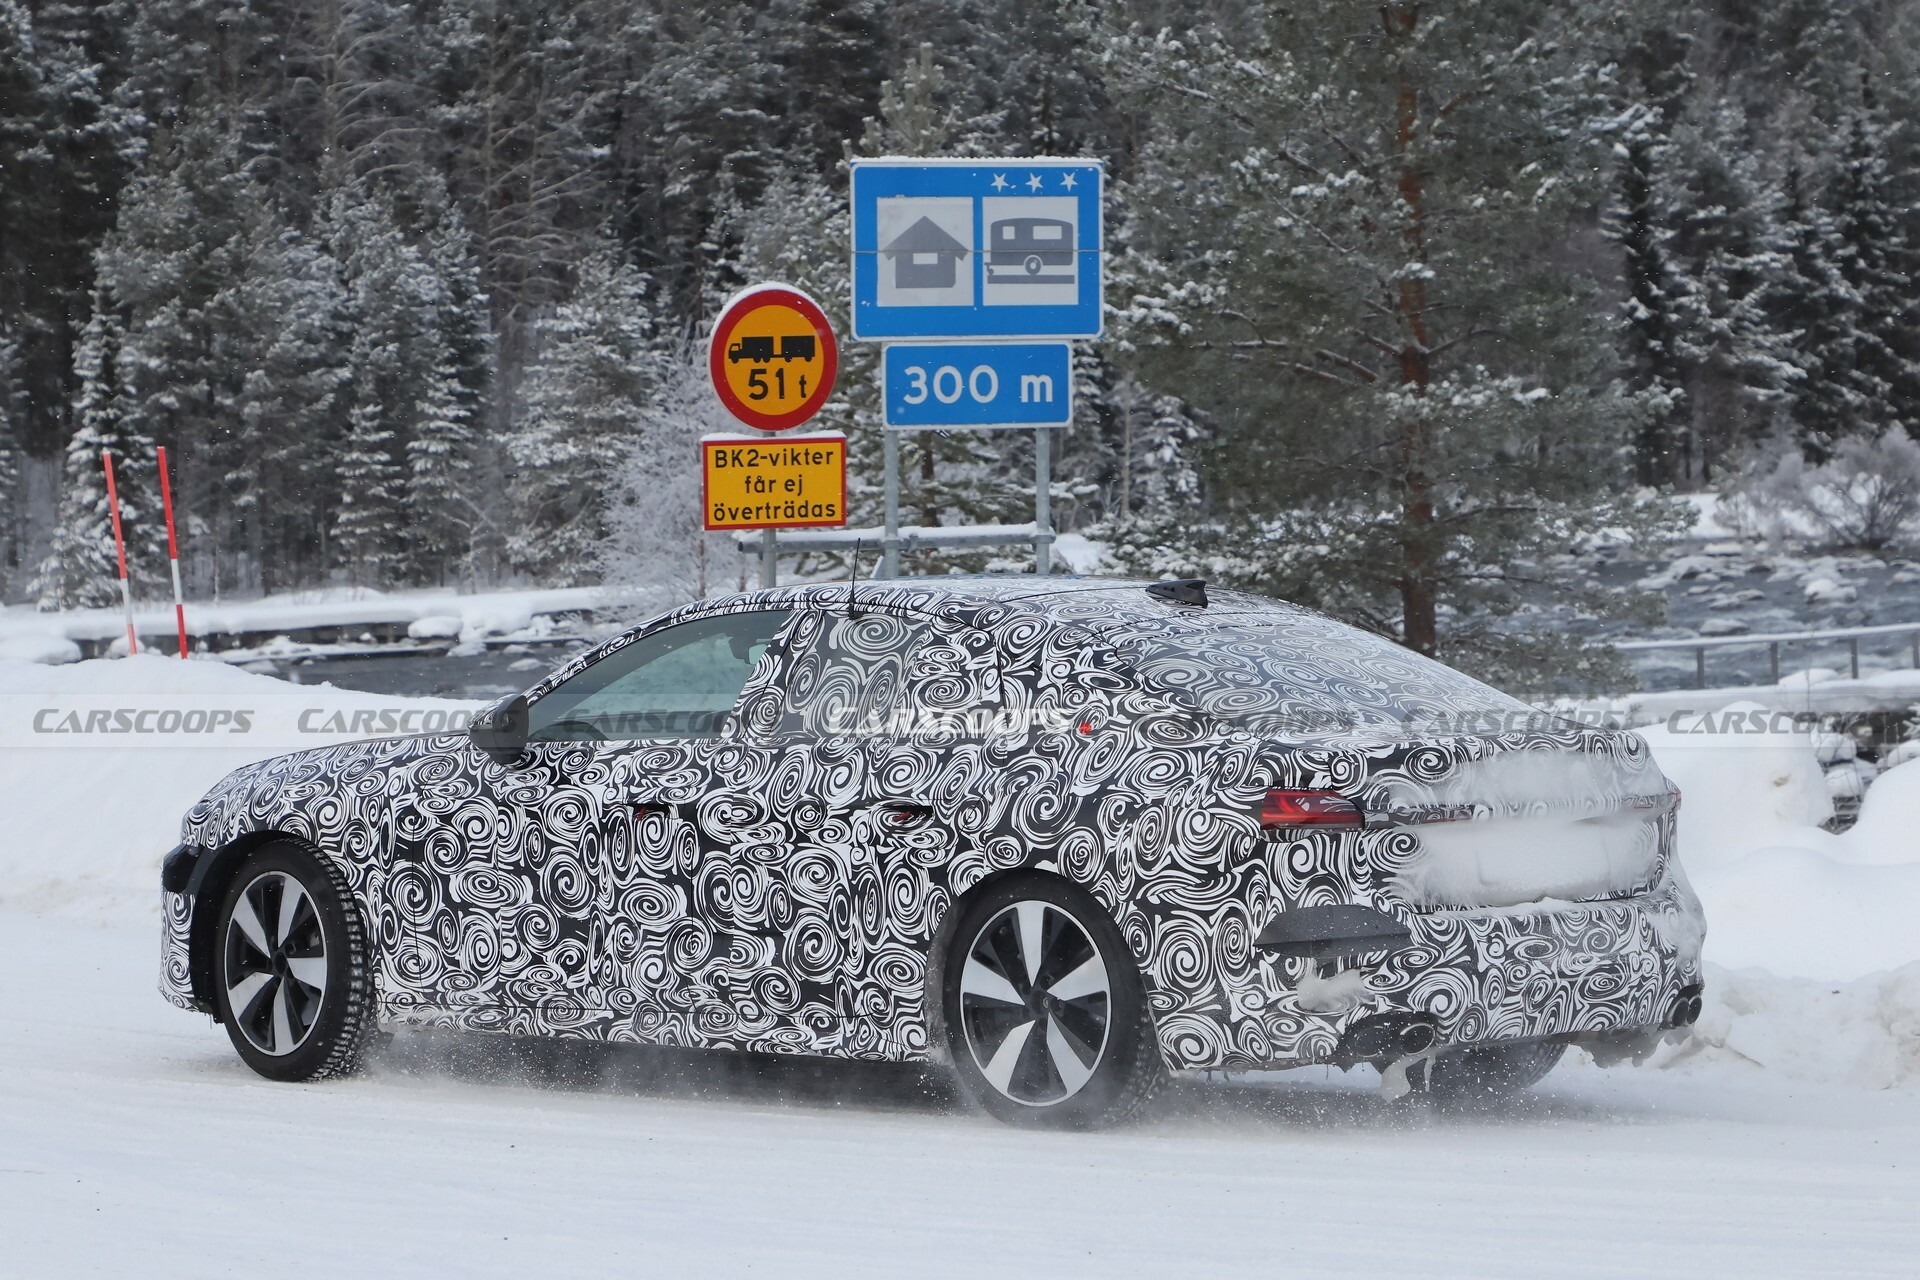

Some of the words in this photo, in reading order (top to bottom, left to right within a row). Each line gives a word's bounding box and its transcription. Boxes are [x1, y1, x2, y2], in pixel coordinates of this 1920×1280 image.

[748, 367, 786, 401] 51
[799, 374, 808, 399] t
[903, 365, 999, 404] 300
[1020, 373, 1053, 403] m
[714, 447, 834, 469] BK2-vikter
[744, 474, 777, 494] får
[784, 474, 803, 497] ej
[713, 499, 836, 522] överträdas
